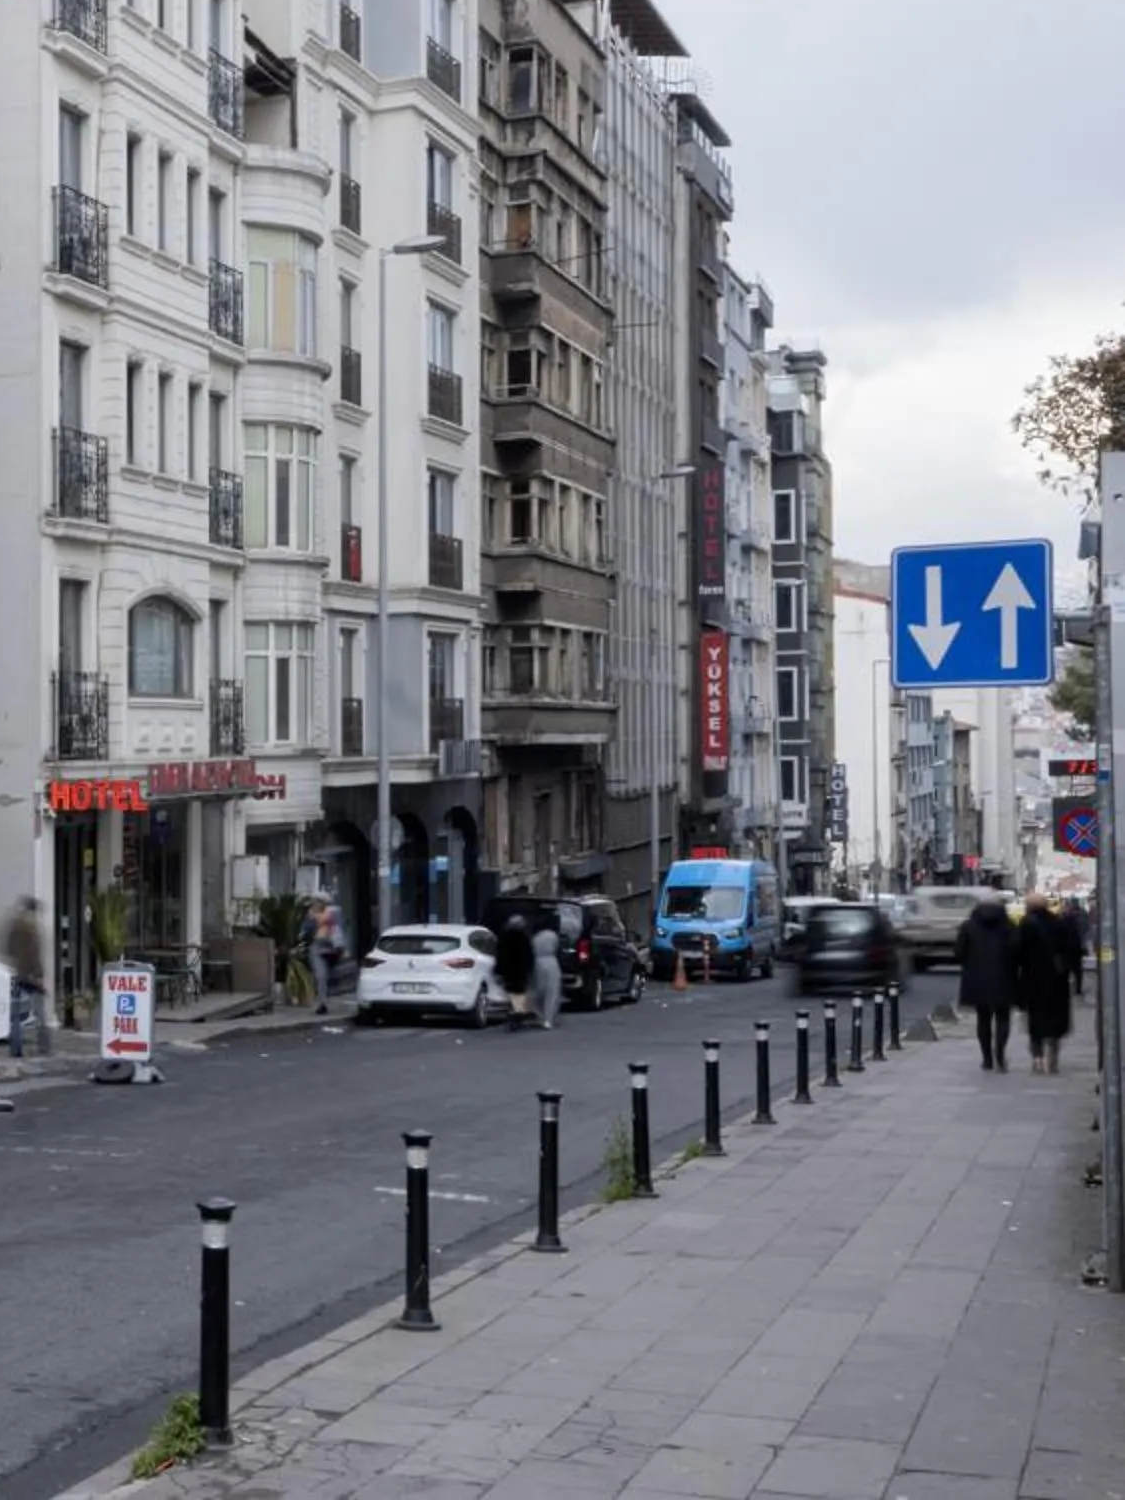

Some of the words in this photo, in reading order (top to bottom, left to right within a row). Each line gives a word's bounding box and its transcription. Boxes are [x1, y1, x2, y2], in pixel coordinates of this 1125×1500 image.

[702, 468, 720, 580] HOTEL
[50, 779, 150, 815] HOTEL
[831, 764, 845, 837] HOTEL
[108, 975, 147, 993] VALE
